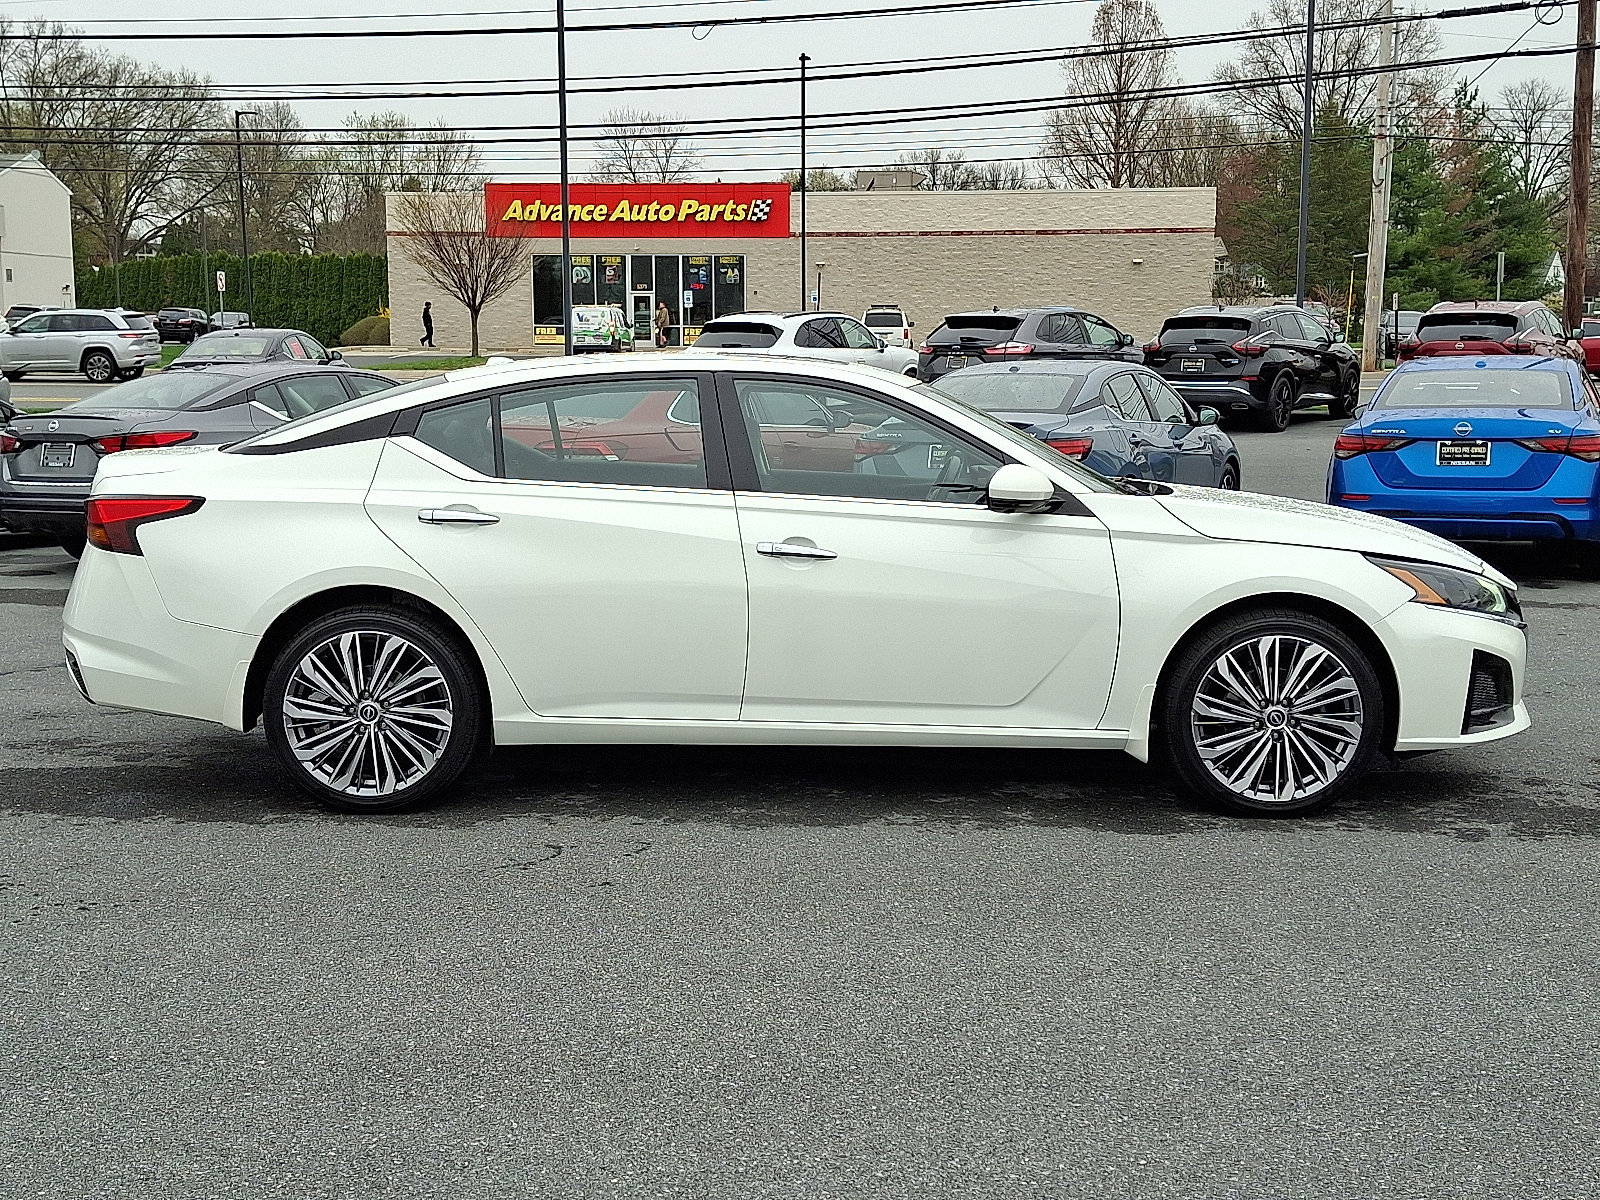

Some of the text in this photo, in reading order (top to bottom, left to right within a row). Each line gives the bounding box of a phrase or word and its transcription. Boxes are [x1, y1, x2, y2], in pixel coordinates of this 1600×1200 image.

[502, 199, 747, 222] Advance Auto Parts
[535, 327, 557, 335] FREE
[684, 327, 703, 336] FRE
